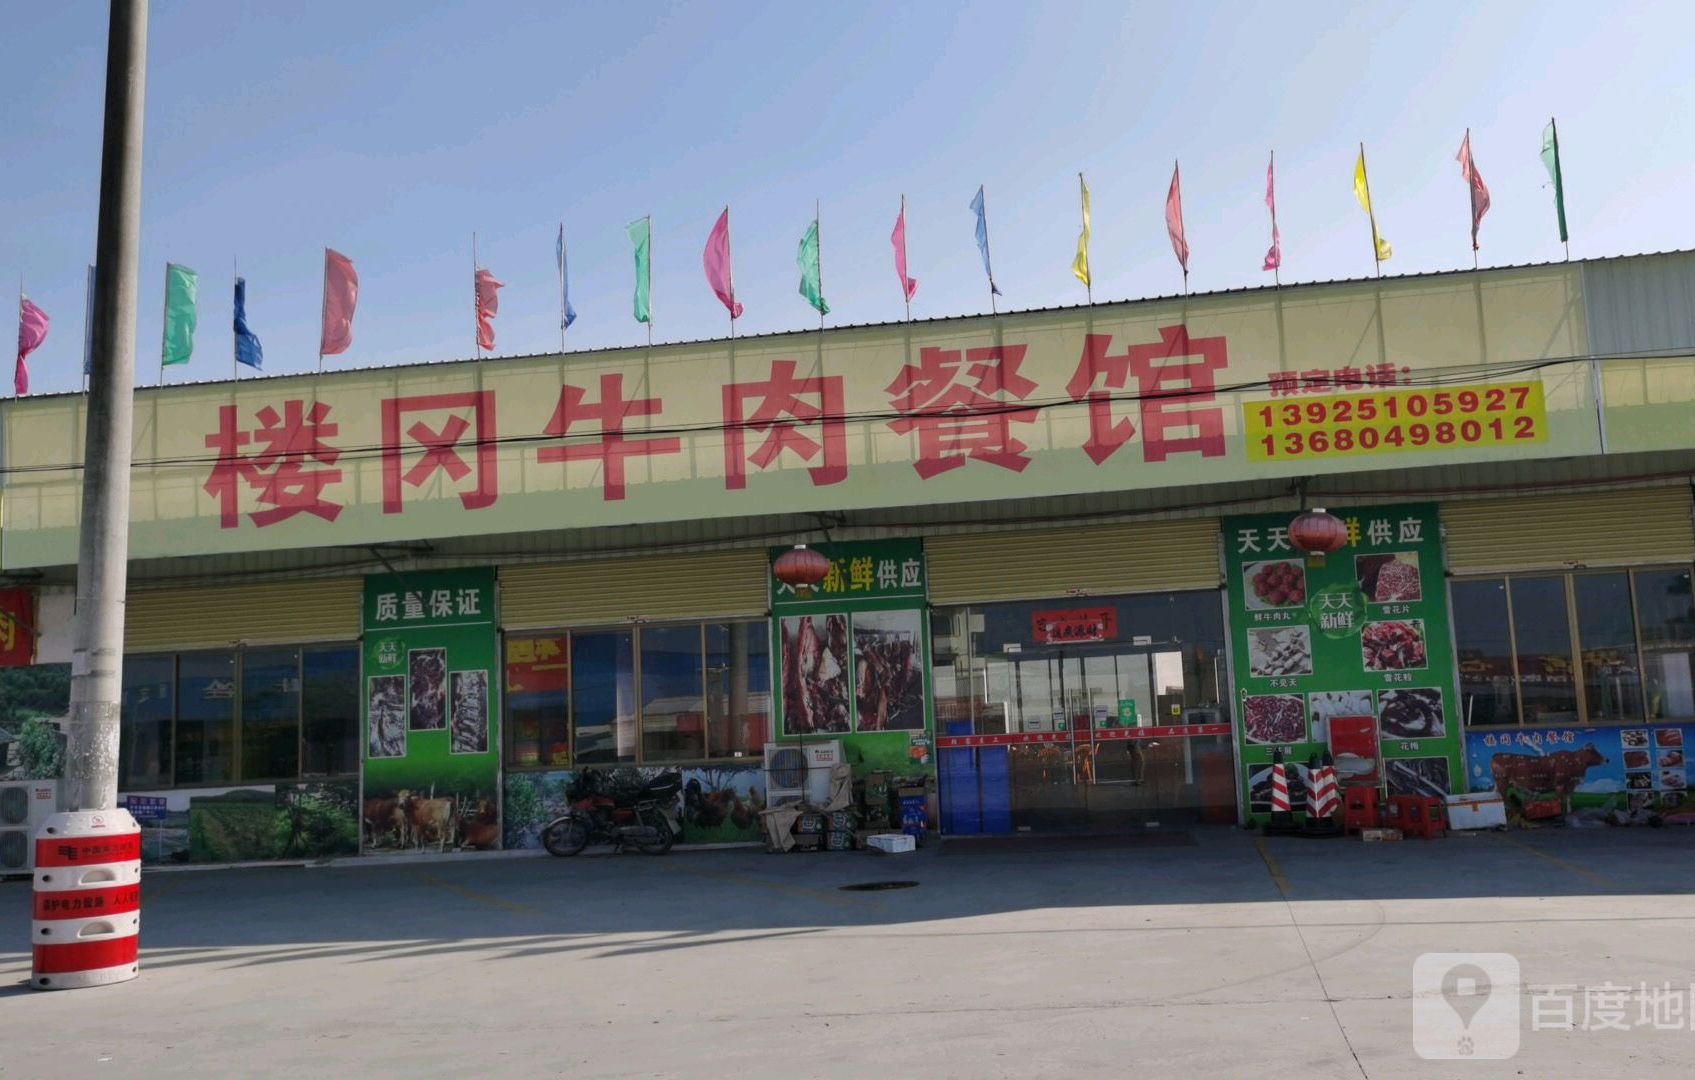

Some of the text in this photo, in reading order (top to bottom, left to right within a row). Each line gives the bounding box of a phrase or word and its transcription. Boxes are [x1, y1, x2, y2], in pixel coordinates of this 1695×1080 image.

[1259, 387, 1531, 427] 13925105927
[204, 324, 1229, 530] 楼冈牛肉餐馆
[1261, 416, 1535, 456] 13680498012
[376, 589, 481, 621] 质量保证
[1319, 593, 1352, 609] 天天
[1320, 612, 1354, 630] 新鲜
[1270, 678, 1297, 688] 不见天
